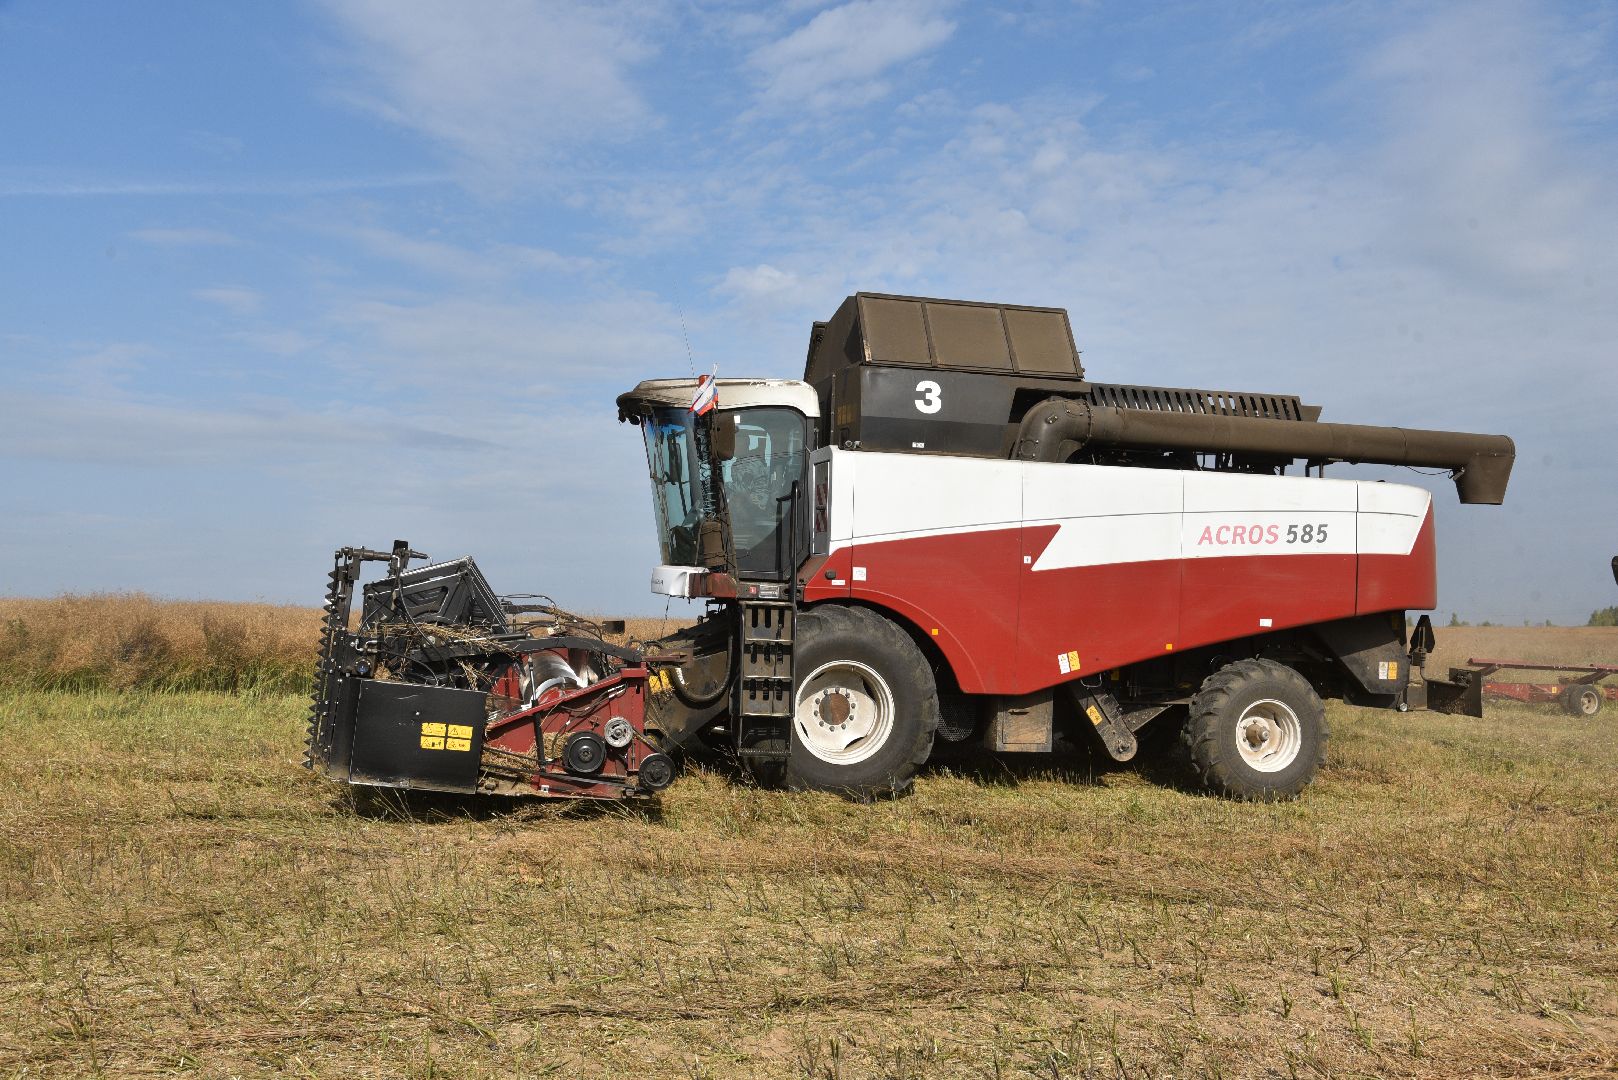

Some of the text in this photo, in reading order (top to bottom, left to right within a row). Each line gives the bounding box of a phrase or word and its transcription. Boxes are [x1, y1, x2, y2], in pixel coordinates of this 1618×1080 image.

[915, 381, 942, 414] 3
[1198, 523, 1328, 545] ACROS 585
